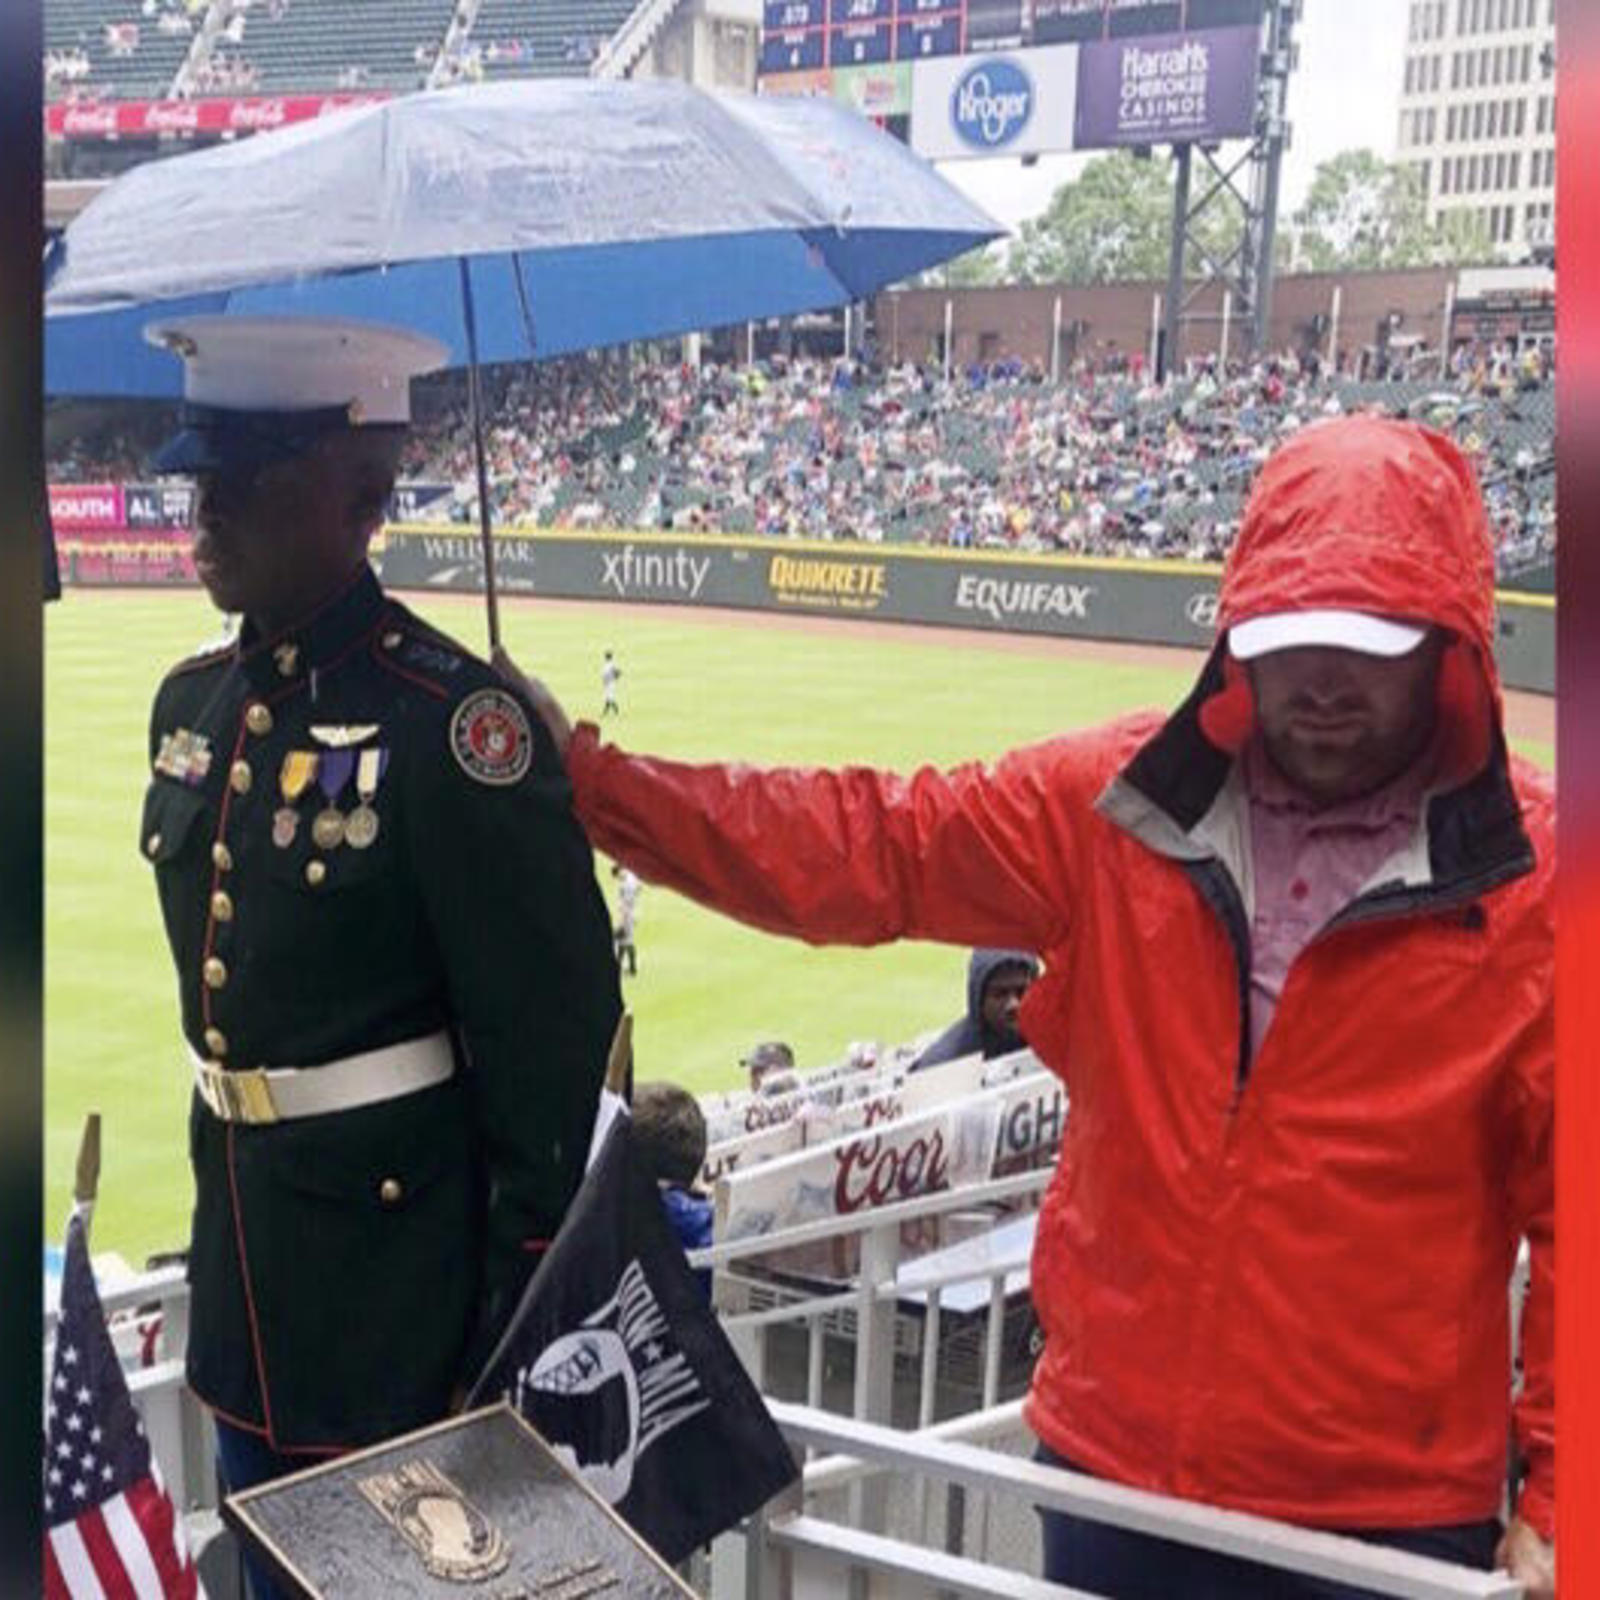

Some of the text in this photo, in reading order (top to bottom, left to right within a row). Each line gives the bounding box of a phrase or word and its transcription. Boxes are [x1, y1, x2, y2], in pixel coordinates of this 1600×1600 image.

[957, 72, 1031, 142] Kroger
[1118, 97, 1206, 120] CASINOS
[602, 545, 710, 599] xfinity
[769, 555, 886, 595] QUIKRETE
[955, 573, 1093, 620] EQUIFAX
[617, 1258, 712, 1459] POW MIA
